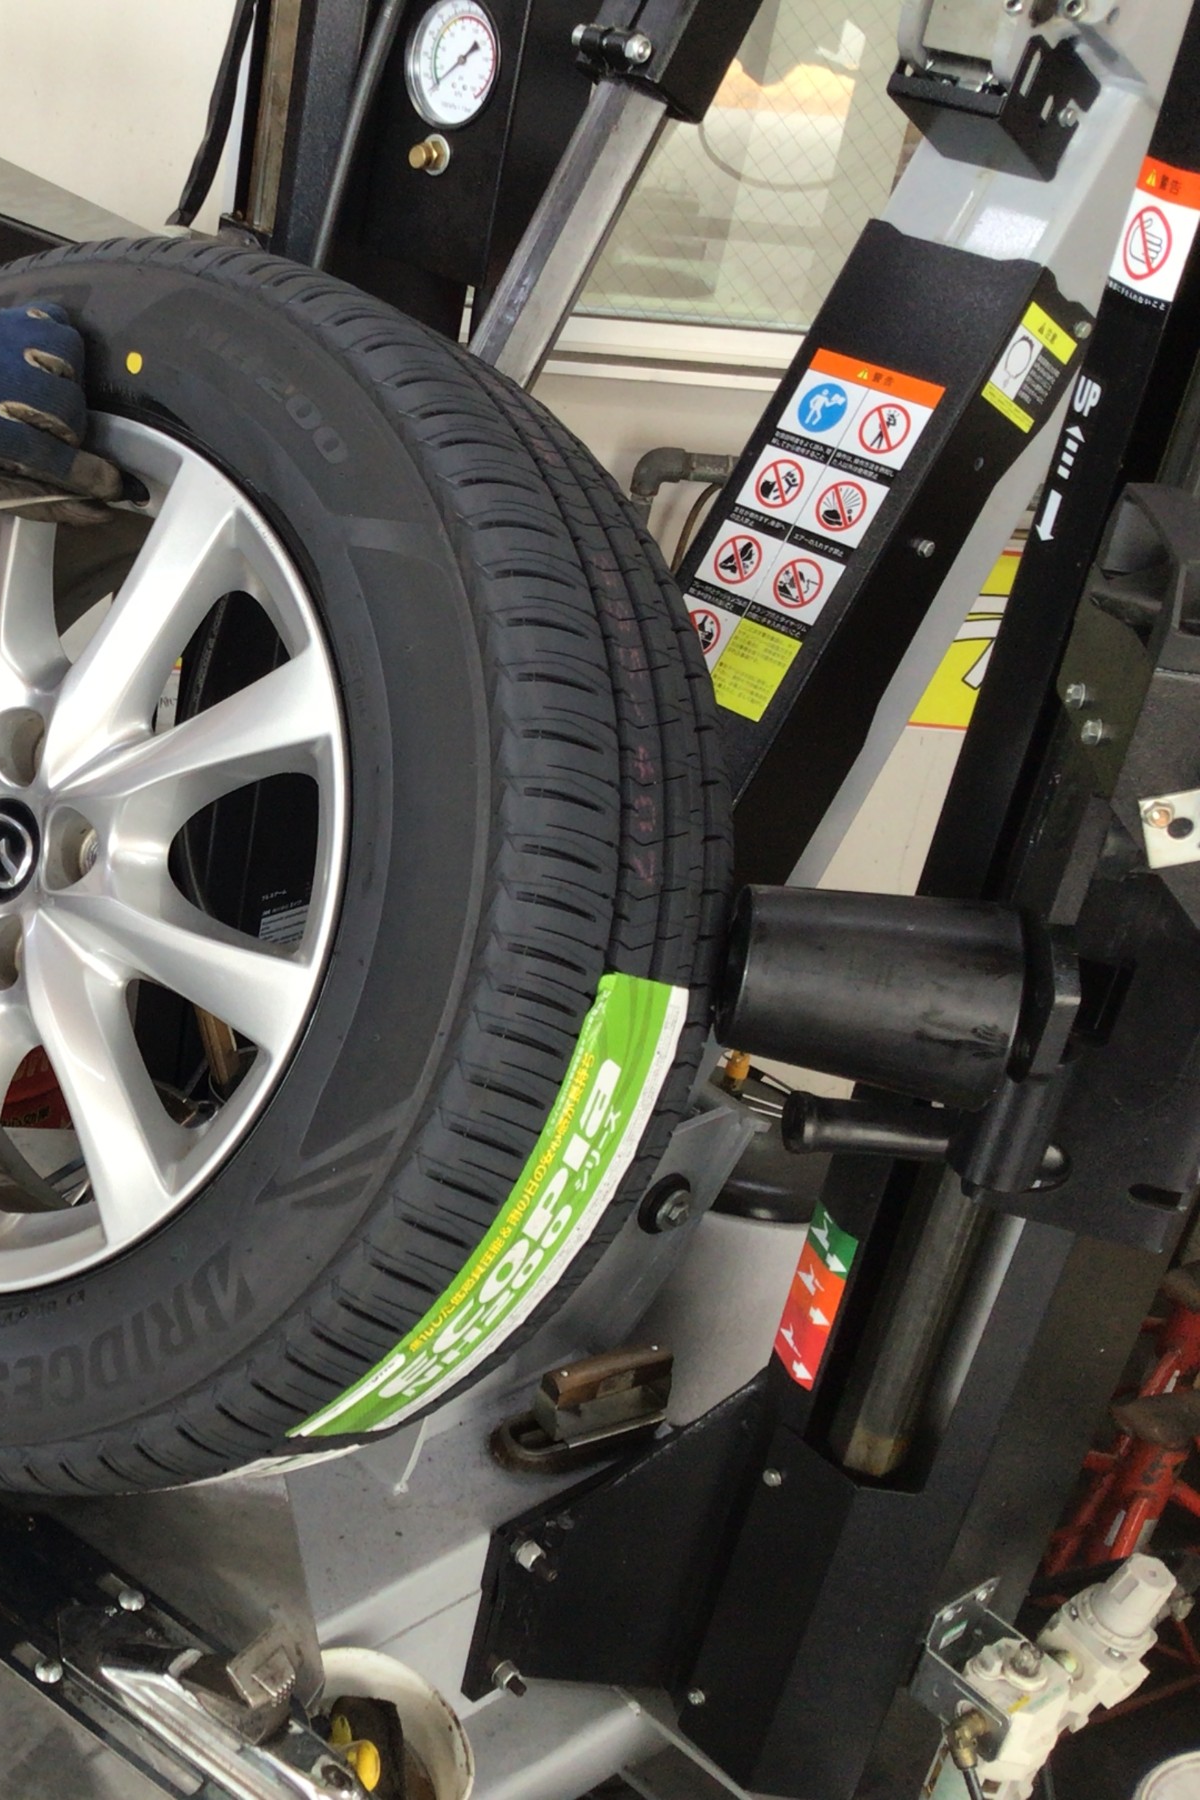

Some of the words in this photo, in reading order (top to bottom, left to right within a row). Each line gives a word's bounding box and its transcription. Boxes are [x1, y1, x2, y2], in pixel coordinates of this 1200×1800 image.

[1073, 375, 1101, 417] UP
[574, 1104, 621, 1190] シリーズ
[401, 1205, 572, 1396] NH200
